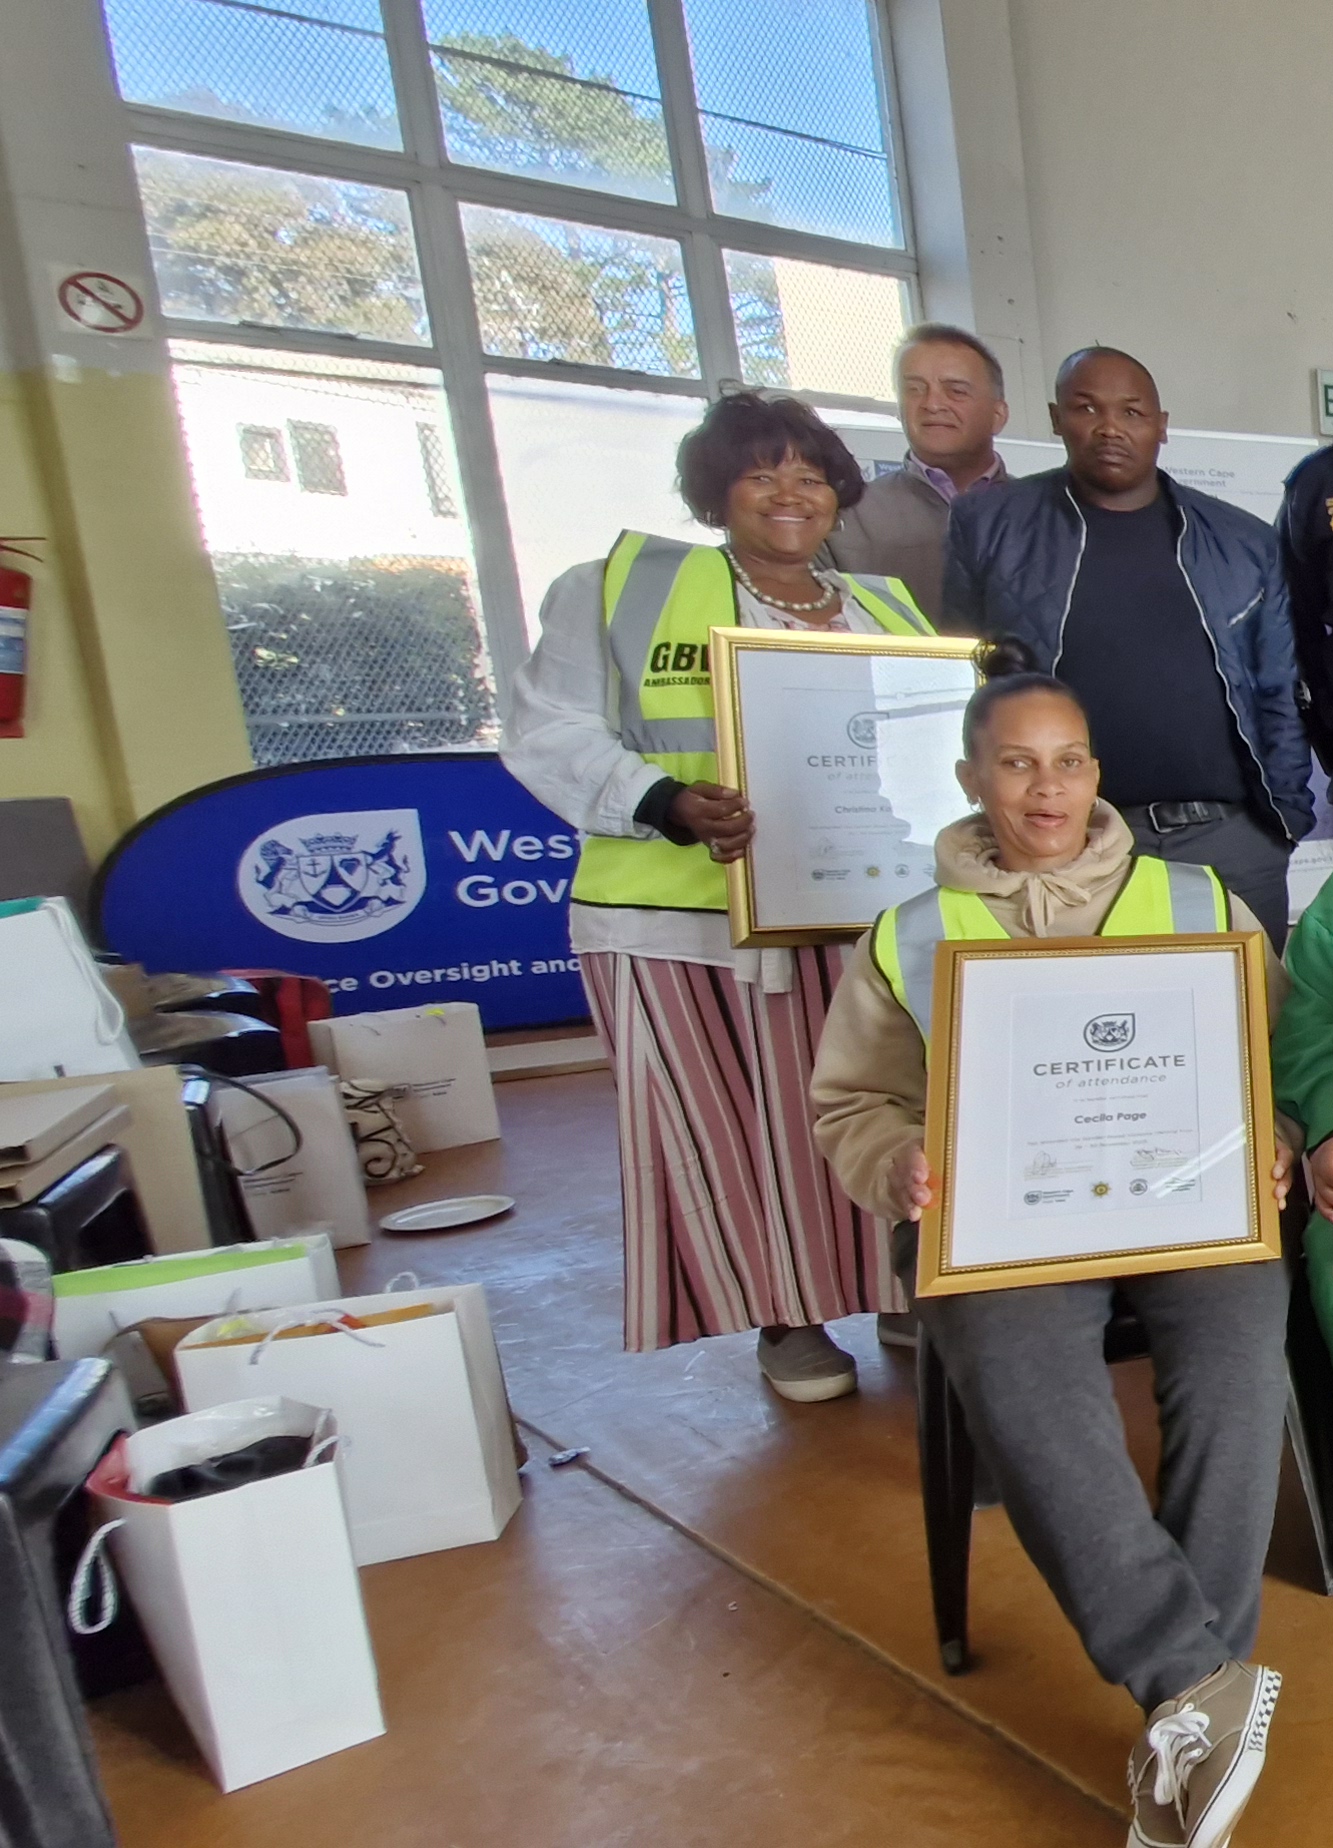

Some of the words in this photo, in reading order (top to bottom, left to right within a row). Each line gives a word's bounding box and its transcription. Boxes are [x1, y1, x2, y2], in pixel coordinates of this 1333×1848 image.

[1208, 467, 1236, 479] Cape
[807, 755, 878, 768] CERTIF
[448, 829, 577, 863] Wes
[369, 957, 523, 990] Oversight
[1033, 1054, 1187, 1076] CERTIFICATE
[1055, 1078, 1074, 1090] of
[1078, 1073, 1167, 1089] attendance
[1116, 1111, 1148, 1123] Page
